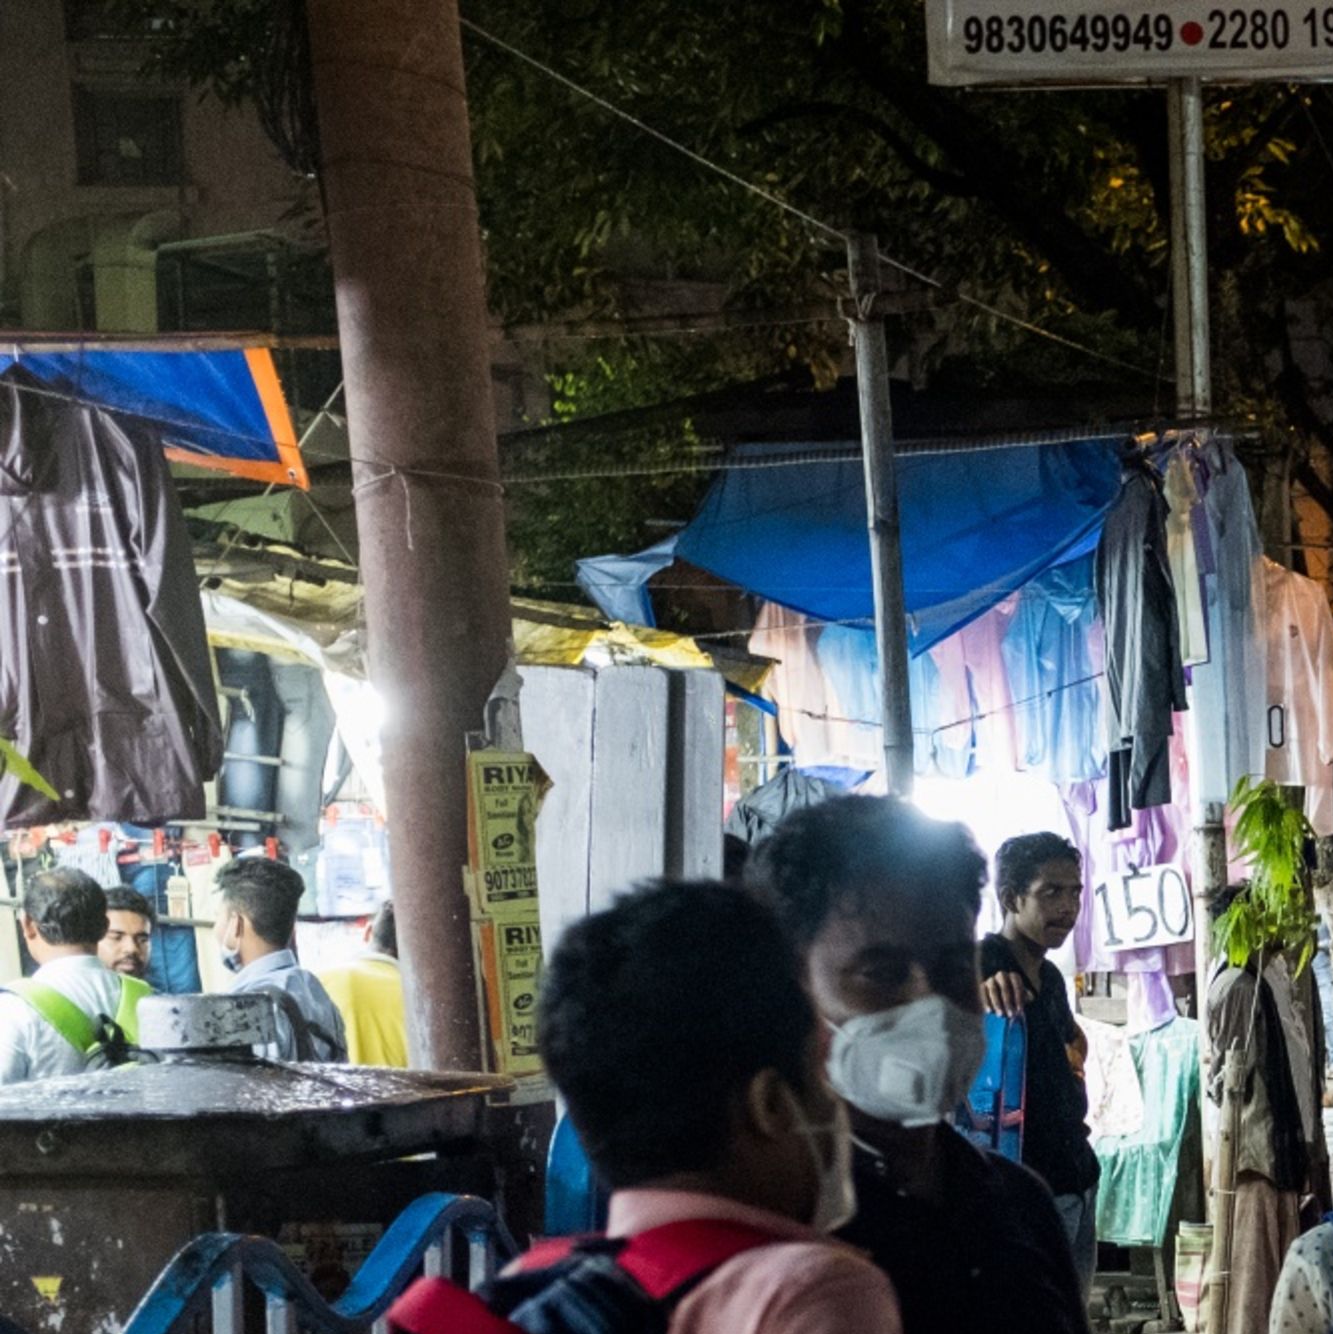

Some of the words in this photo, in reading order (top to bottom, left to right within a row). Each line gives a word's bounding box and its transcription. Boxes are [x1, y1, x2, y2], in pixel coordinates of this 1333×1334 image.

[963, 13, 1173, 54] 9830649949
[1207, 9, 1290, 50] 2280
[1095, 868, 1189, 946] 150
